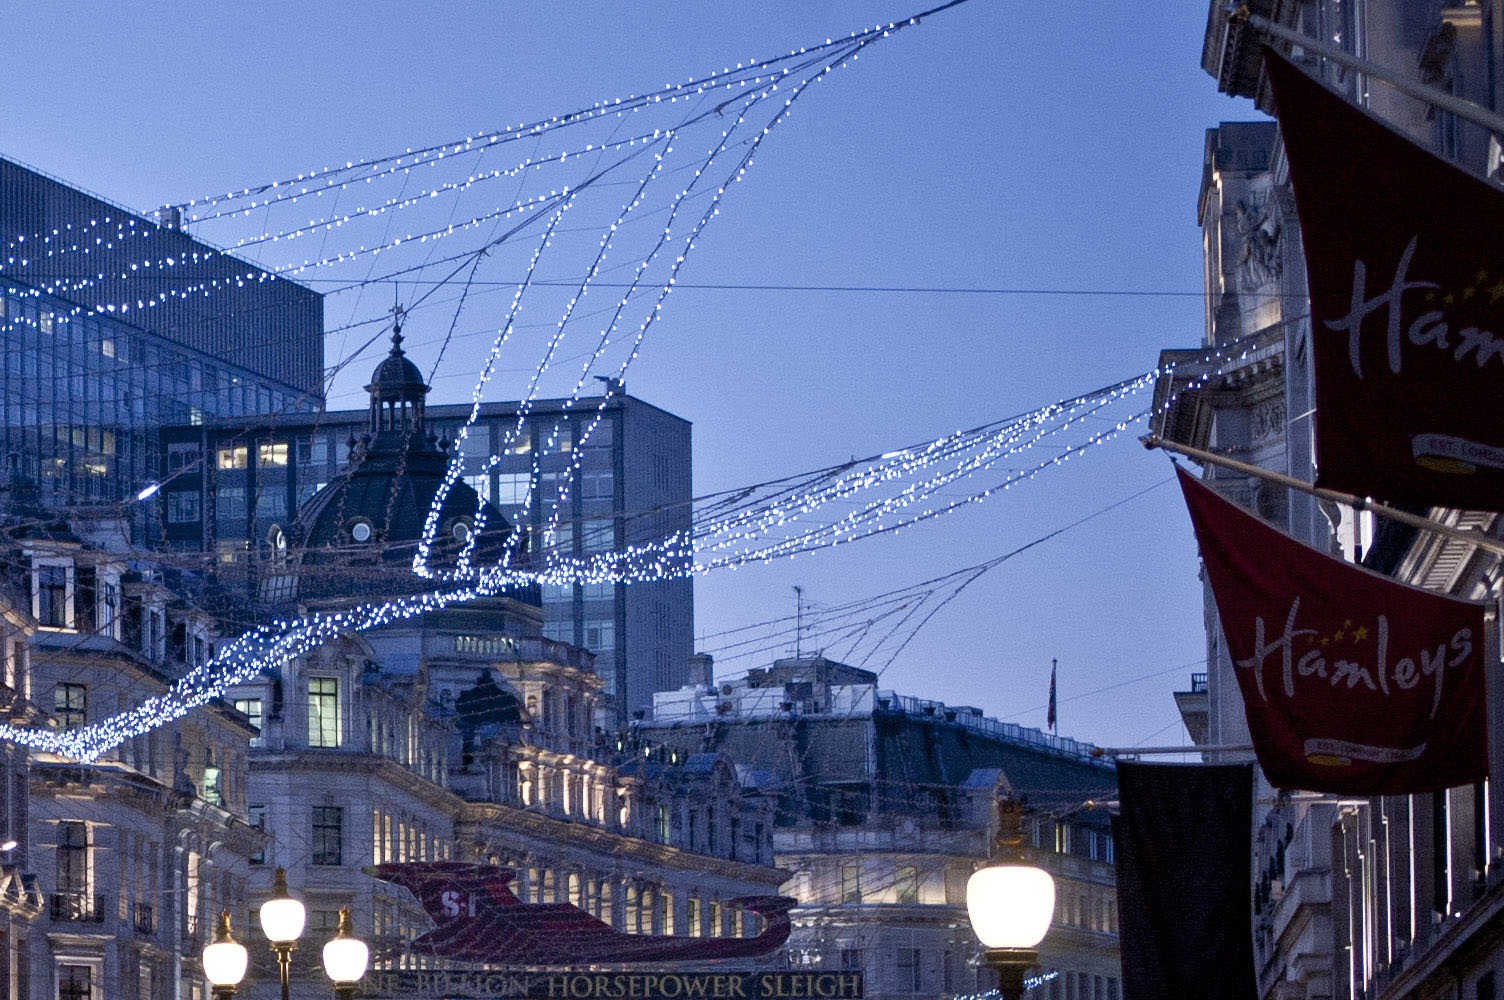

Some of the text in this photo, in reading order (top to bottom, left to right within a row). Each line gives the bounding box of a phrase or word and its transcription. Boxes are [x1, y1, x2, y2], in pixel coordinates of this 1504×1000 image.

[1236, 595, 1473, 720] Hamleys
[549, 974, 747, 998] HORSEPOWER
[760, 973, 860, 998] SLEIGH
